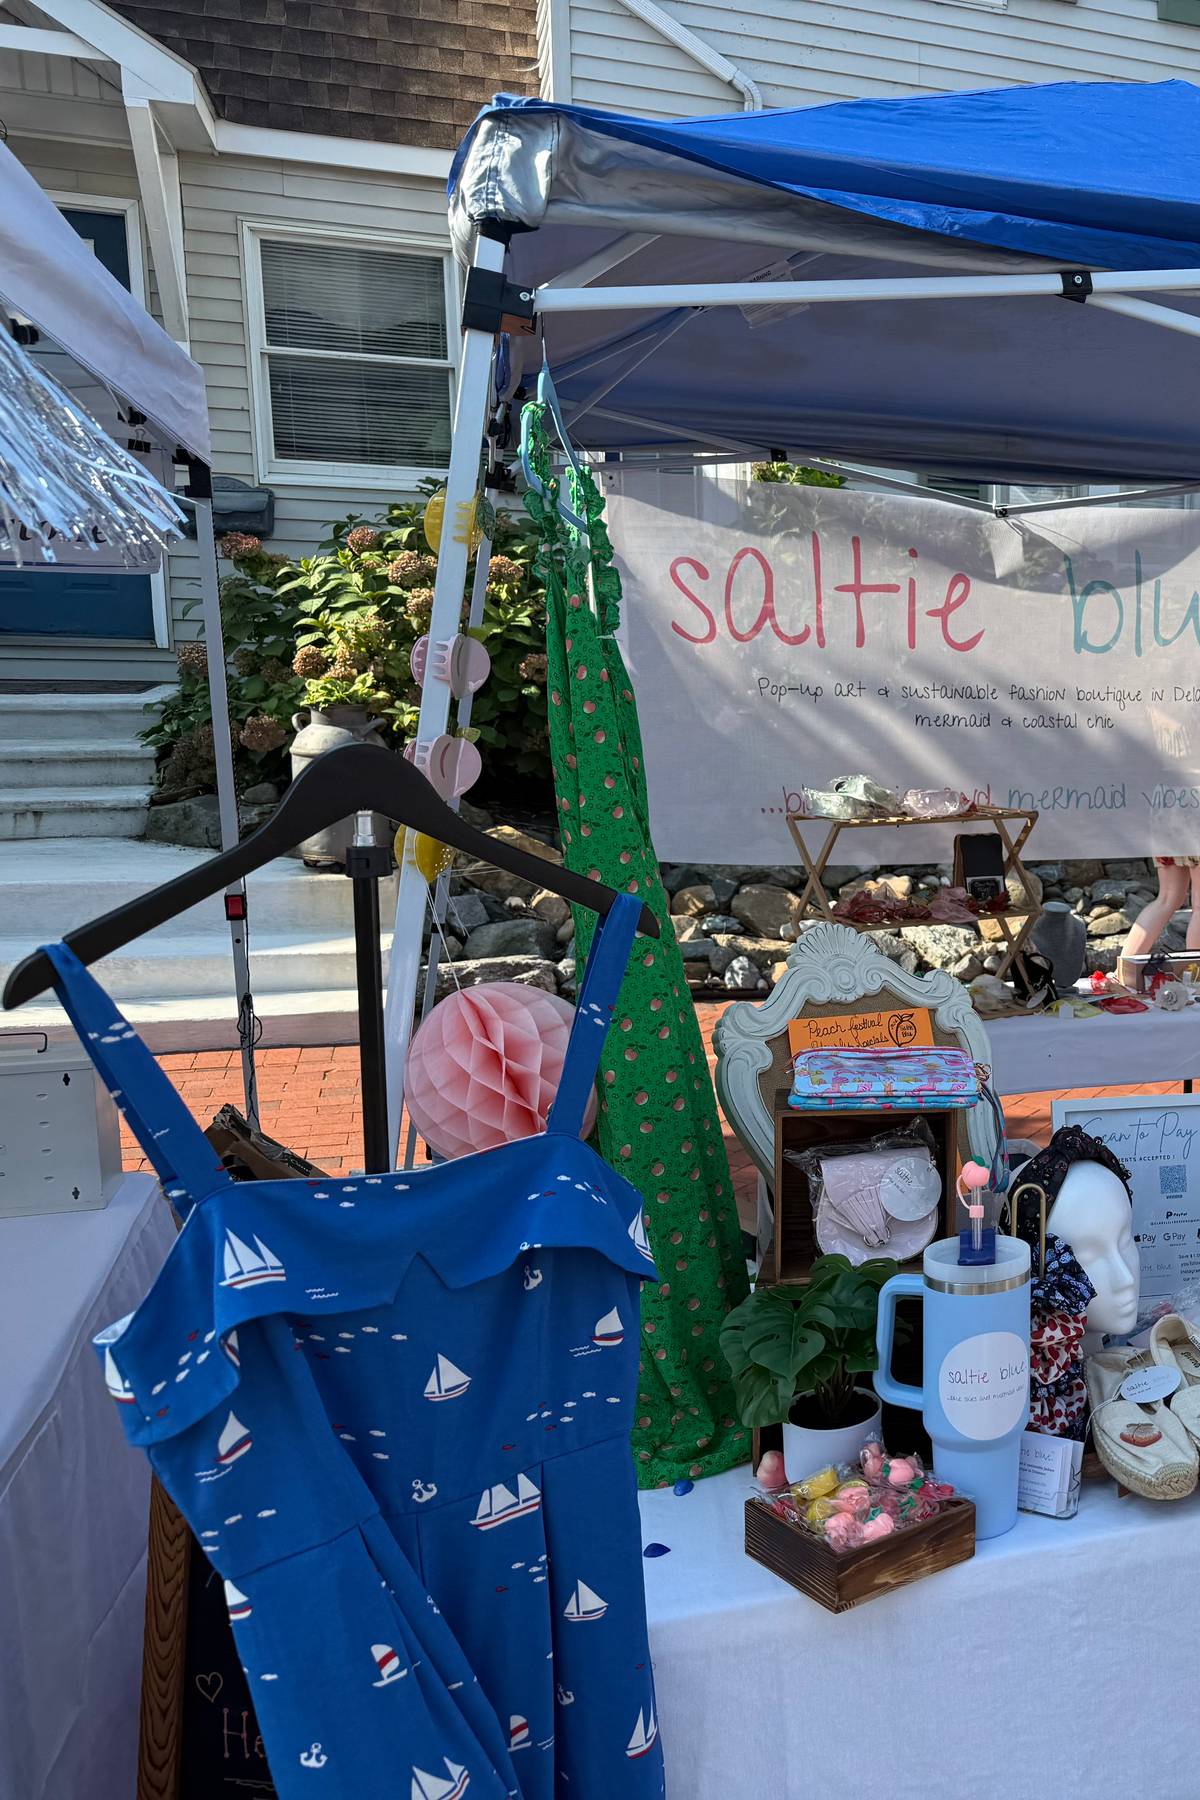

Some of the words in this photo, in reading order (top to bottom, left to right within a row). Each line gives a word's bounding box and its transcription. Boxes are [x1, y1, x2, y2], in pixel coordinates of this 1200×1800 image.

[669, 530, 985, 652] saltie
[758, 677, 823, 702] Pop-up
[1076, 686, 1142, 711] boutique
[1023, 713, 1078, 729] coastal
[1087, 713, 1115, 729] chic
[1142, 784, 1200, 809] vibes
[803, 1019, 846, 1039] Peach
[1129, 1118, 1153, 1156] to
[1156, 1111, 1199, 1160] Pay
[1139, 1154, 1170, 1162] ACCEPTED
[948, 1368, 989, 1385] saltie
